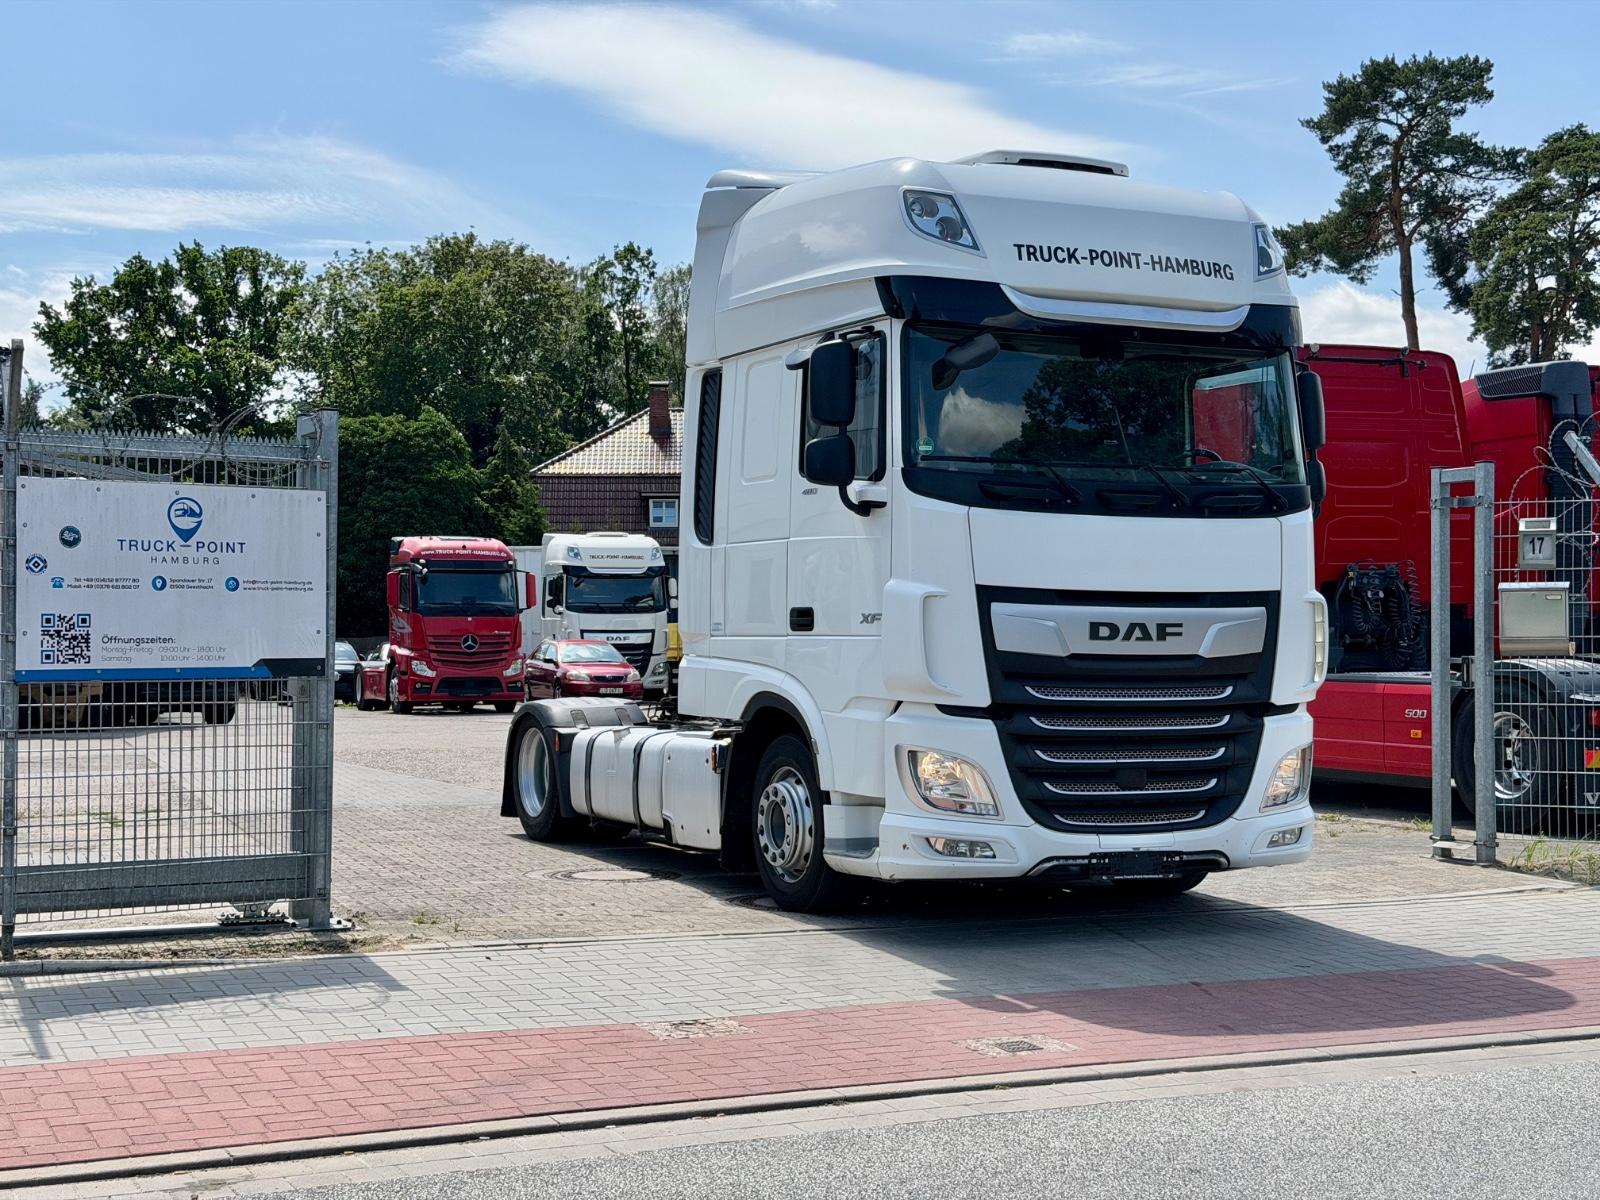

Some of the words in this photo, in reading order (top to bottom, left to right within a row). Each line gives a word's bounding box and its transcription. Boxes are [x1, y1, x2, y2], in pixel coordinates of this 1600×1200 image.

[1012, 243, 1235, 281] TRUCK-POINT-HAMBURG
[1529, 536, 1545, 555] 17
[150, 556, 221, 565] HAMBURG
[859, 612, 883, 625] XF
[1088, 621, 1184, 642] DAF
[101, 634, 176, 647] Öffnungszeiten:
[101, 655, 132, 664] Samstag
[1404, 708, 1428, 719] 500
